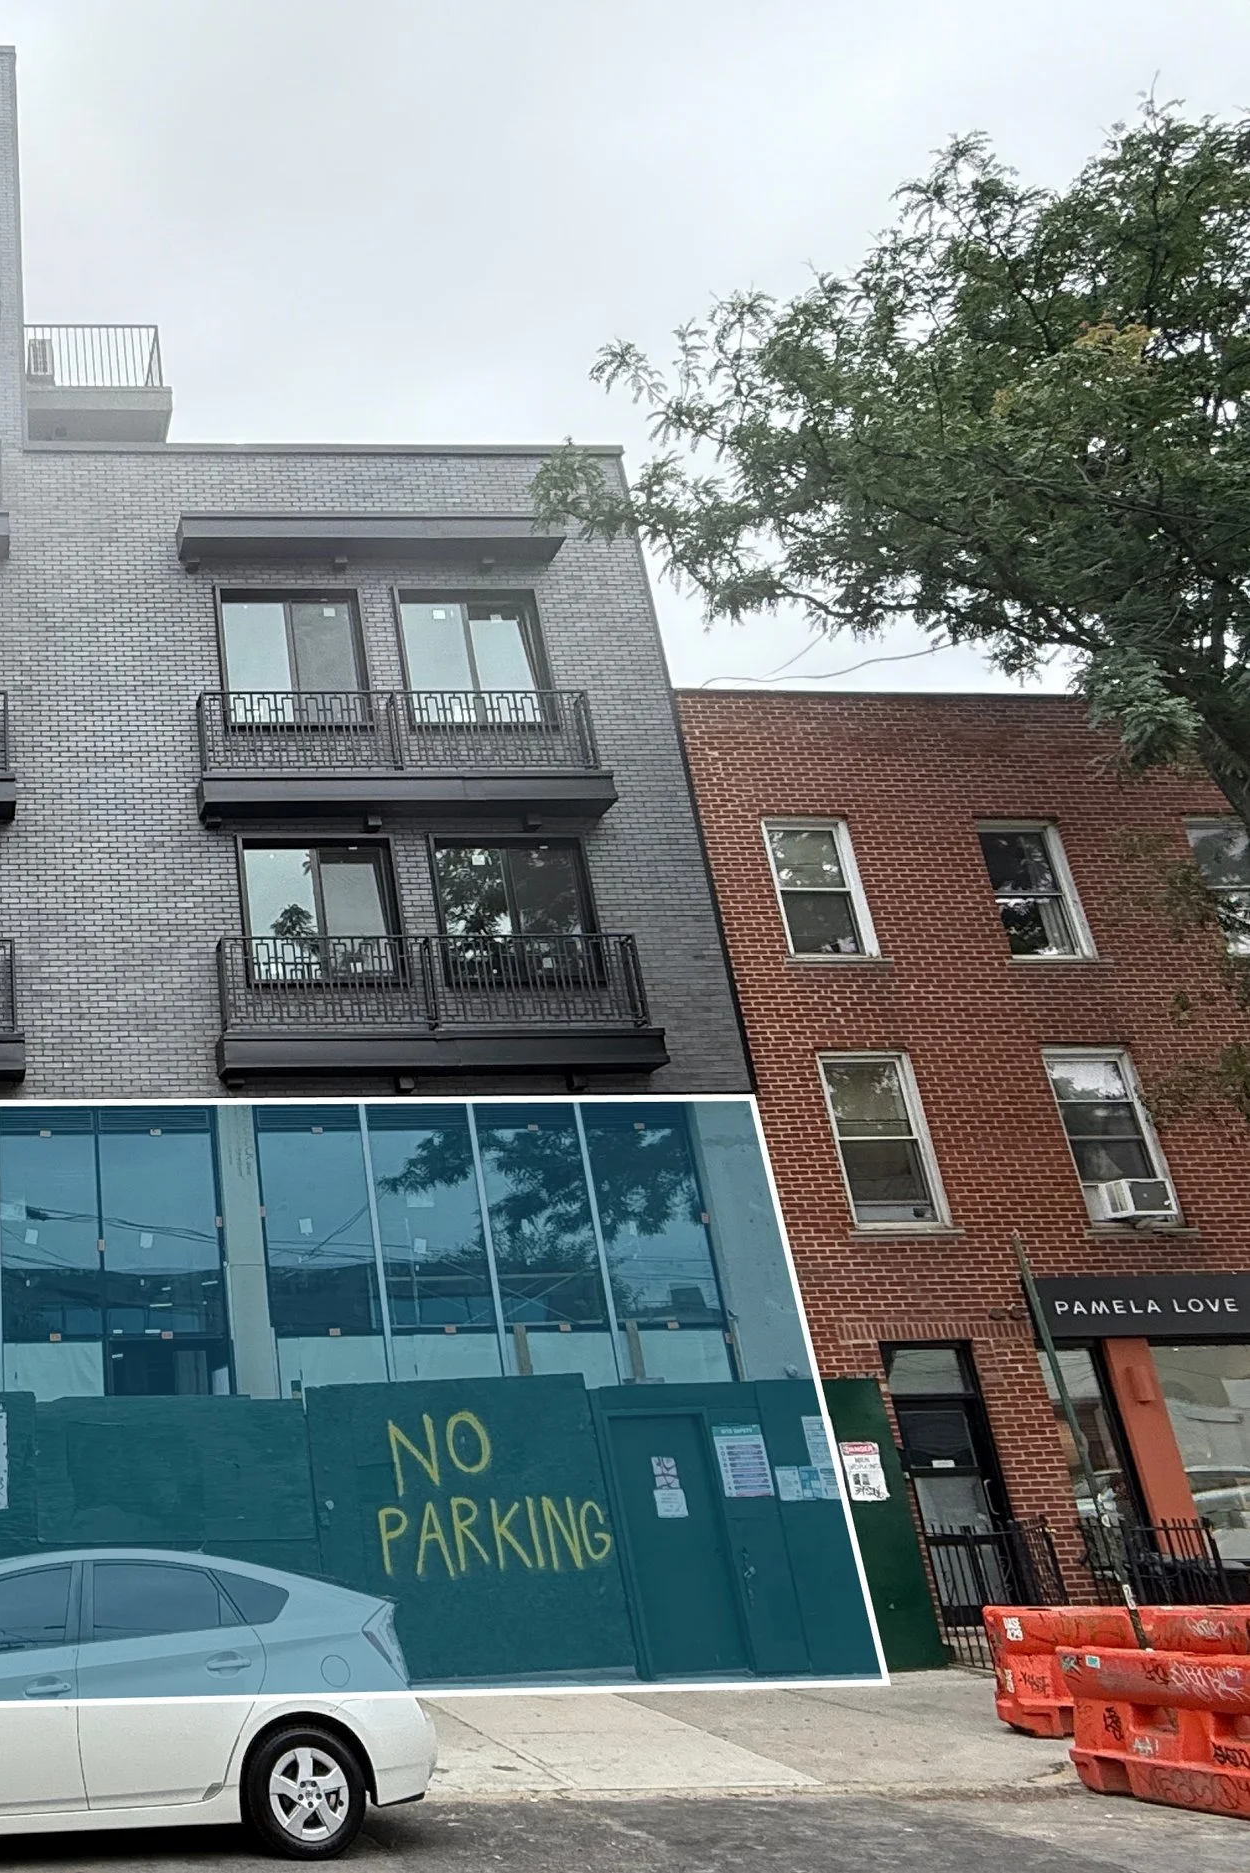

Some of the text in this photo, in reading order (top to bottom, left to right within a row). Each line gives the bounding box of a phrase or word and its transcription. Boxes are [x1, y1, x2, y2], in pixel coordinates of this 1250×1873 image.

[1054, 1298, 1240, 1316] PAMELA LOVE
[387, 1410, 492, 1497] NO
[845, 1445, 873, 1453] DANGER
[378, 1497, 612, 1578] PARKING
